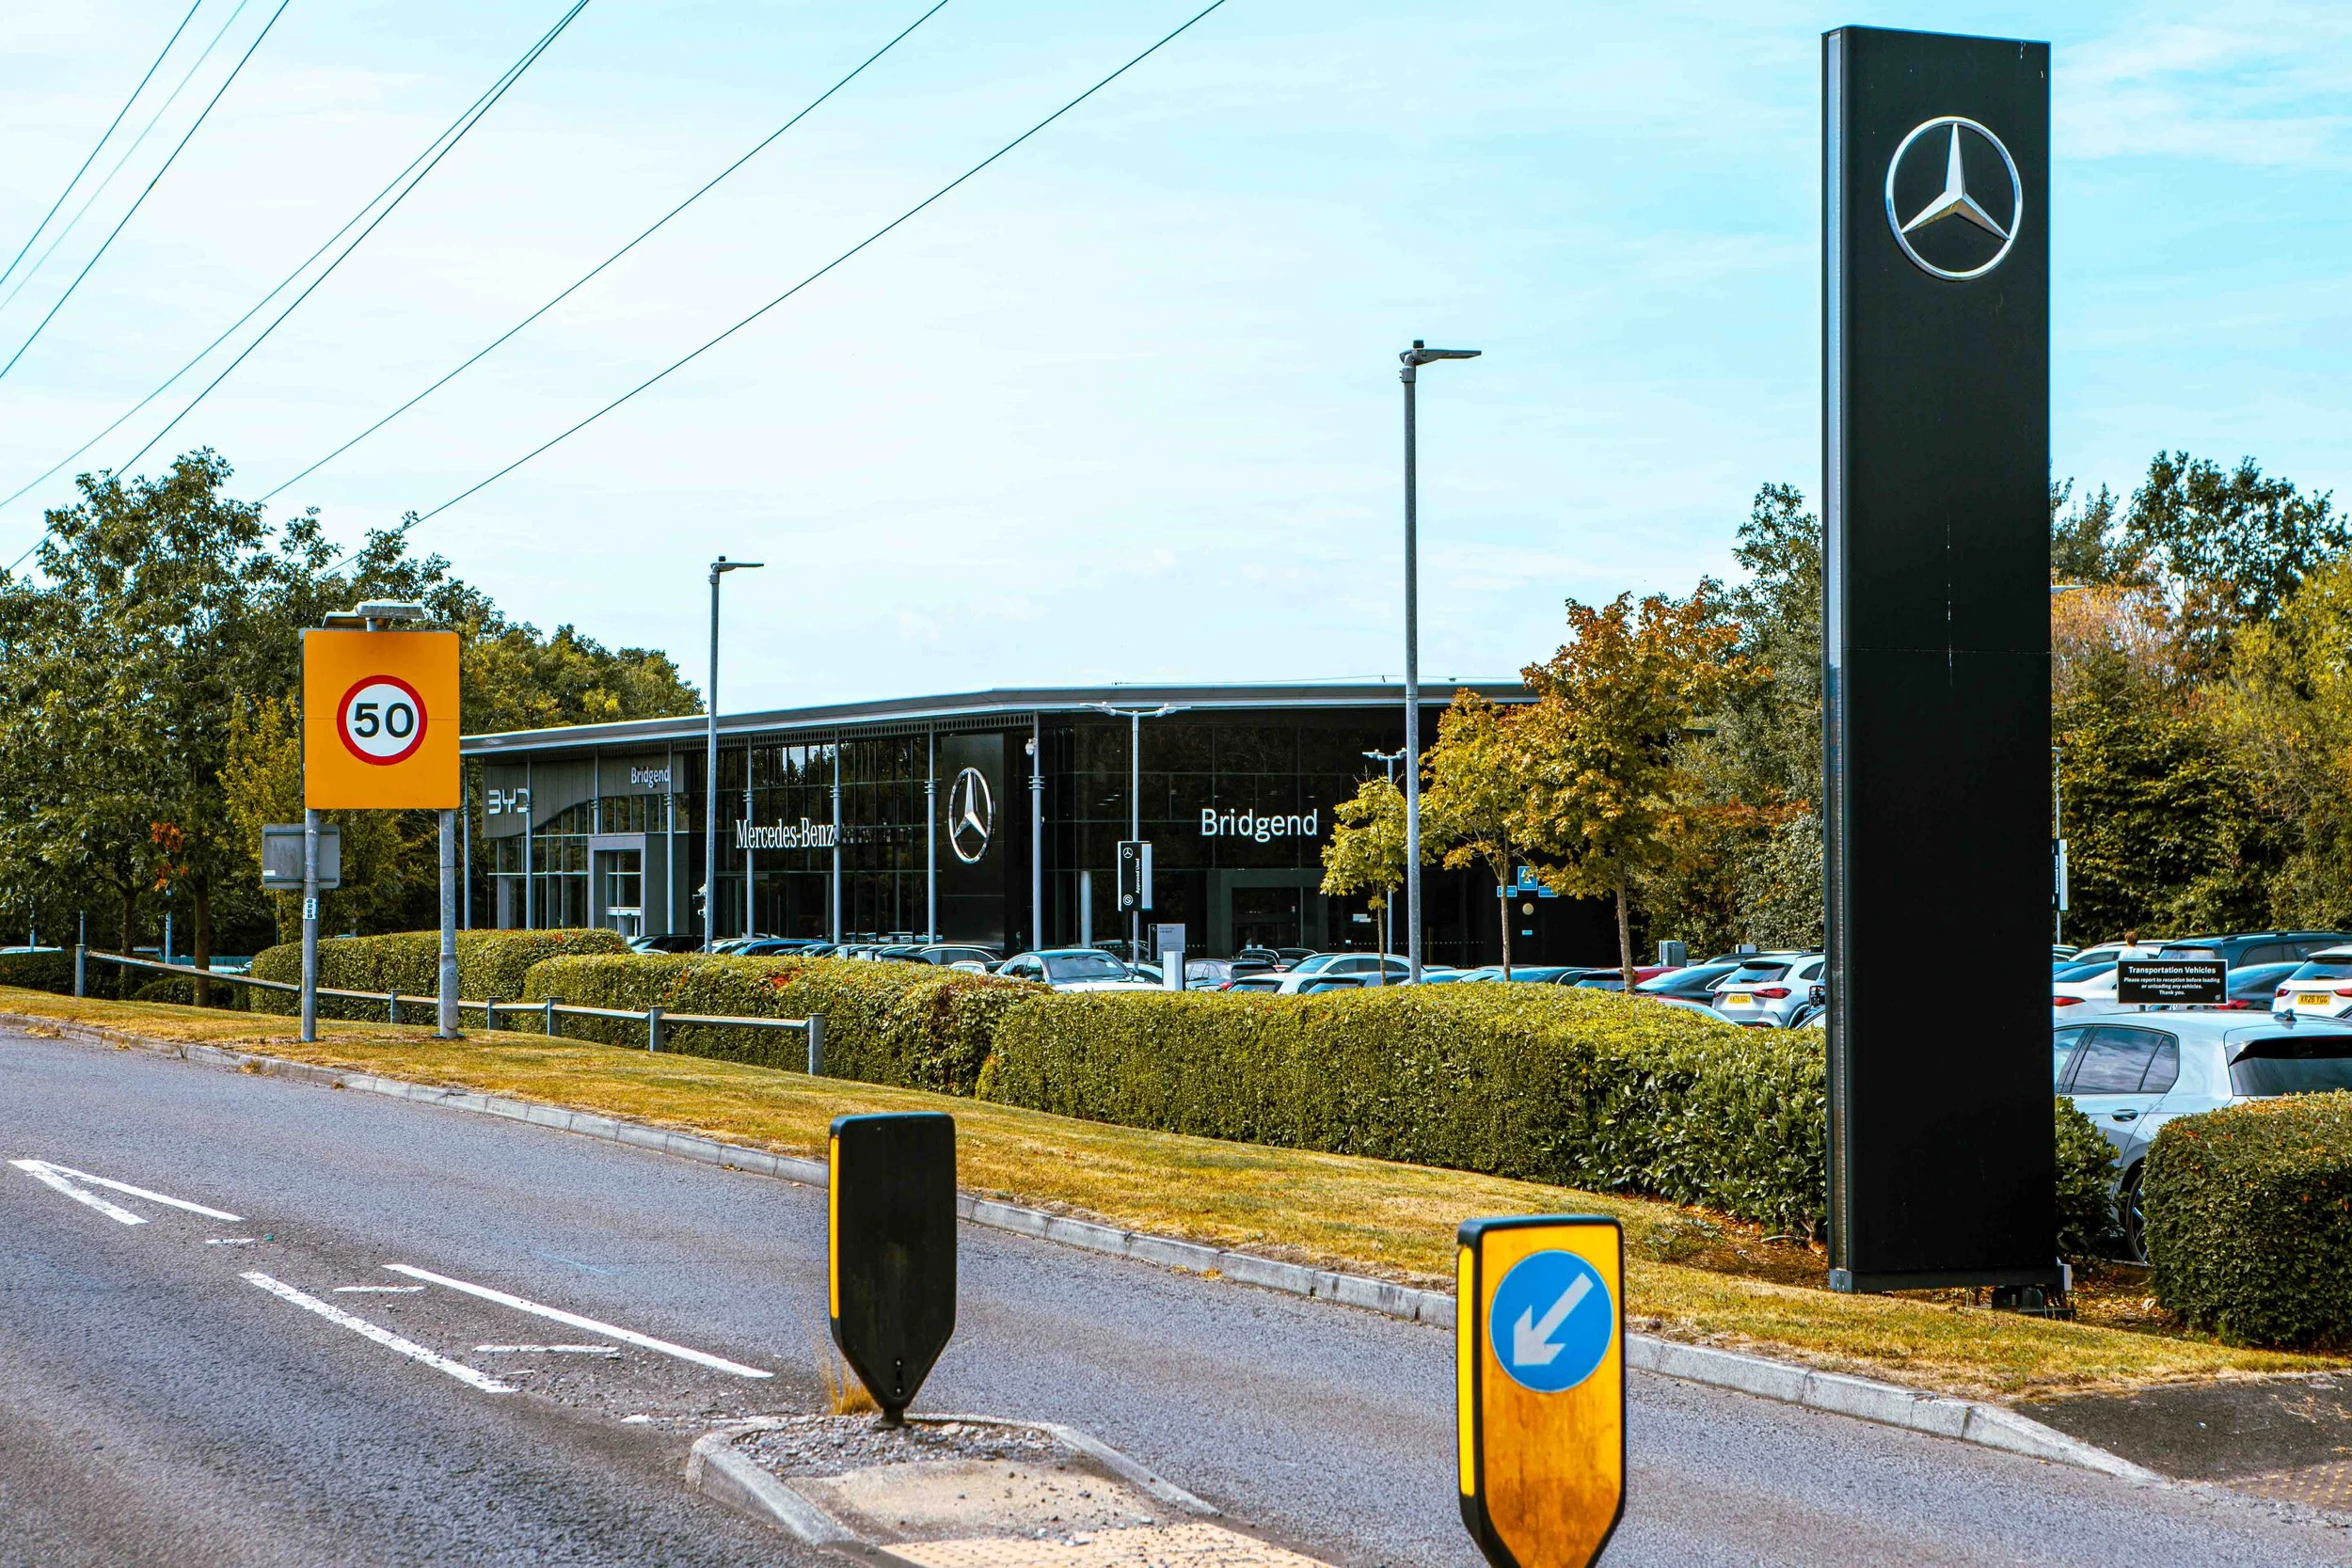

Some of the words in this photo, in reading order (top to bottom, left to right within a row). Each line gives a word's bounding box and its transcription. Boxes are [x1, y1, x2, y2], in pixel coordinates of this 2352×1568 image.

[354, 703, 414, 738] 50
[631, 767, 671, 788] Bridgend
[488, 788, 530, 815] BYD
[736, 817, 835, 848] Mercedes-Benz
[1201, 808, 1318, 843] Bridgend
[2128, 966, 2183, 974] Transportation
